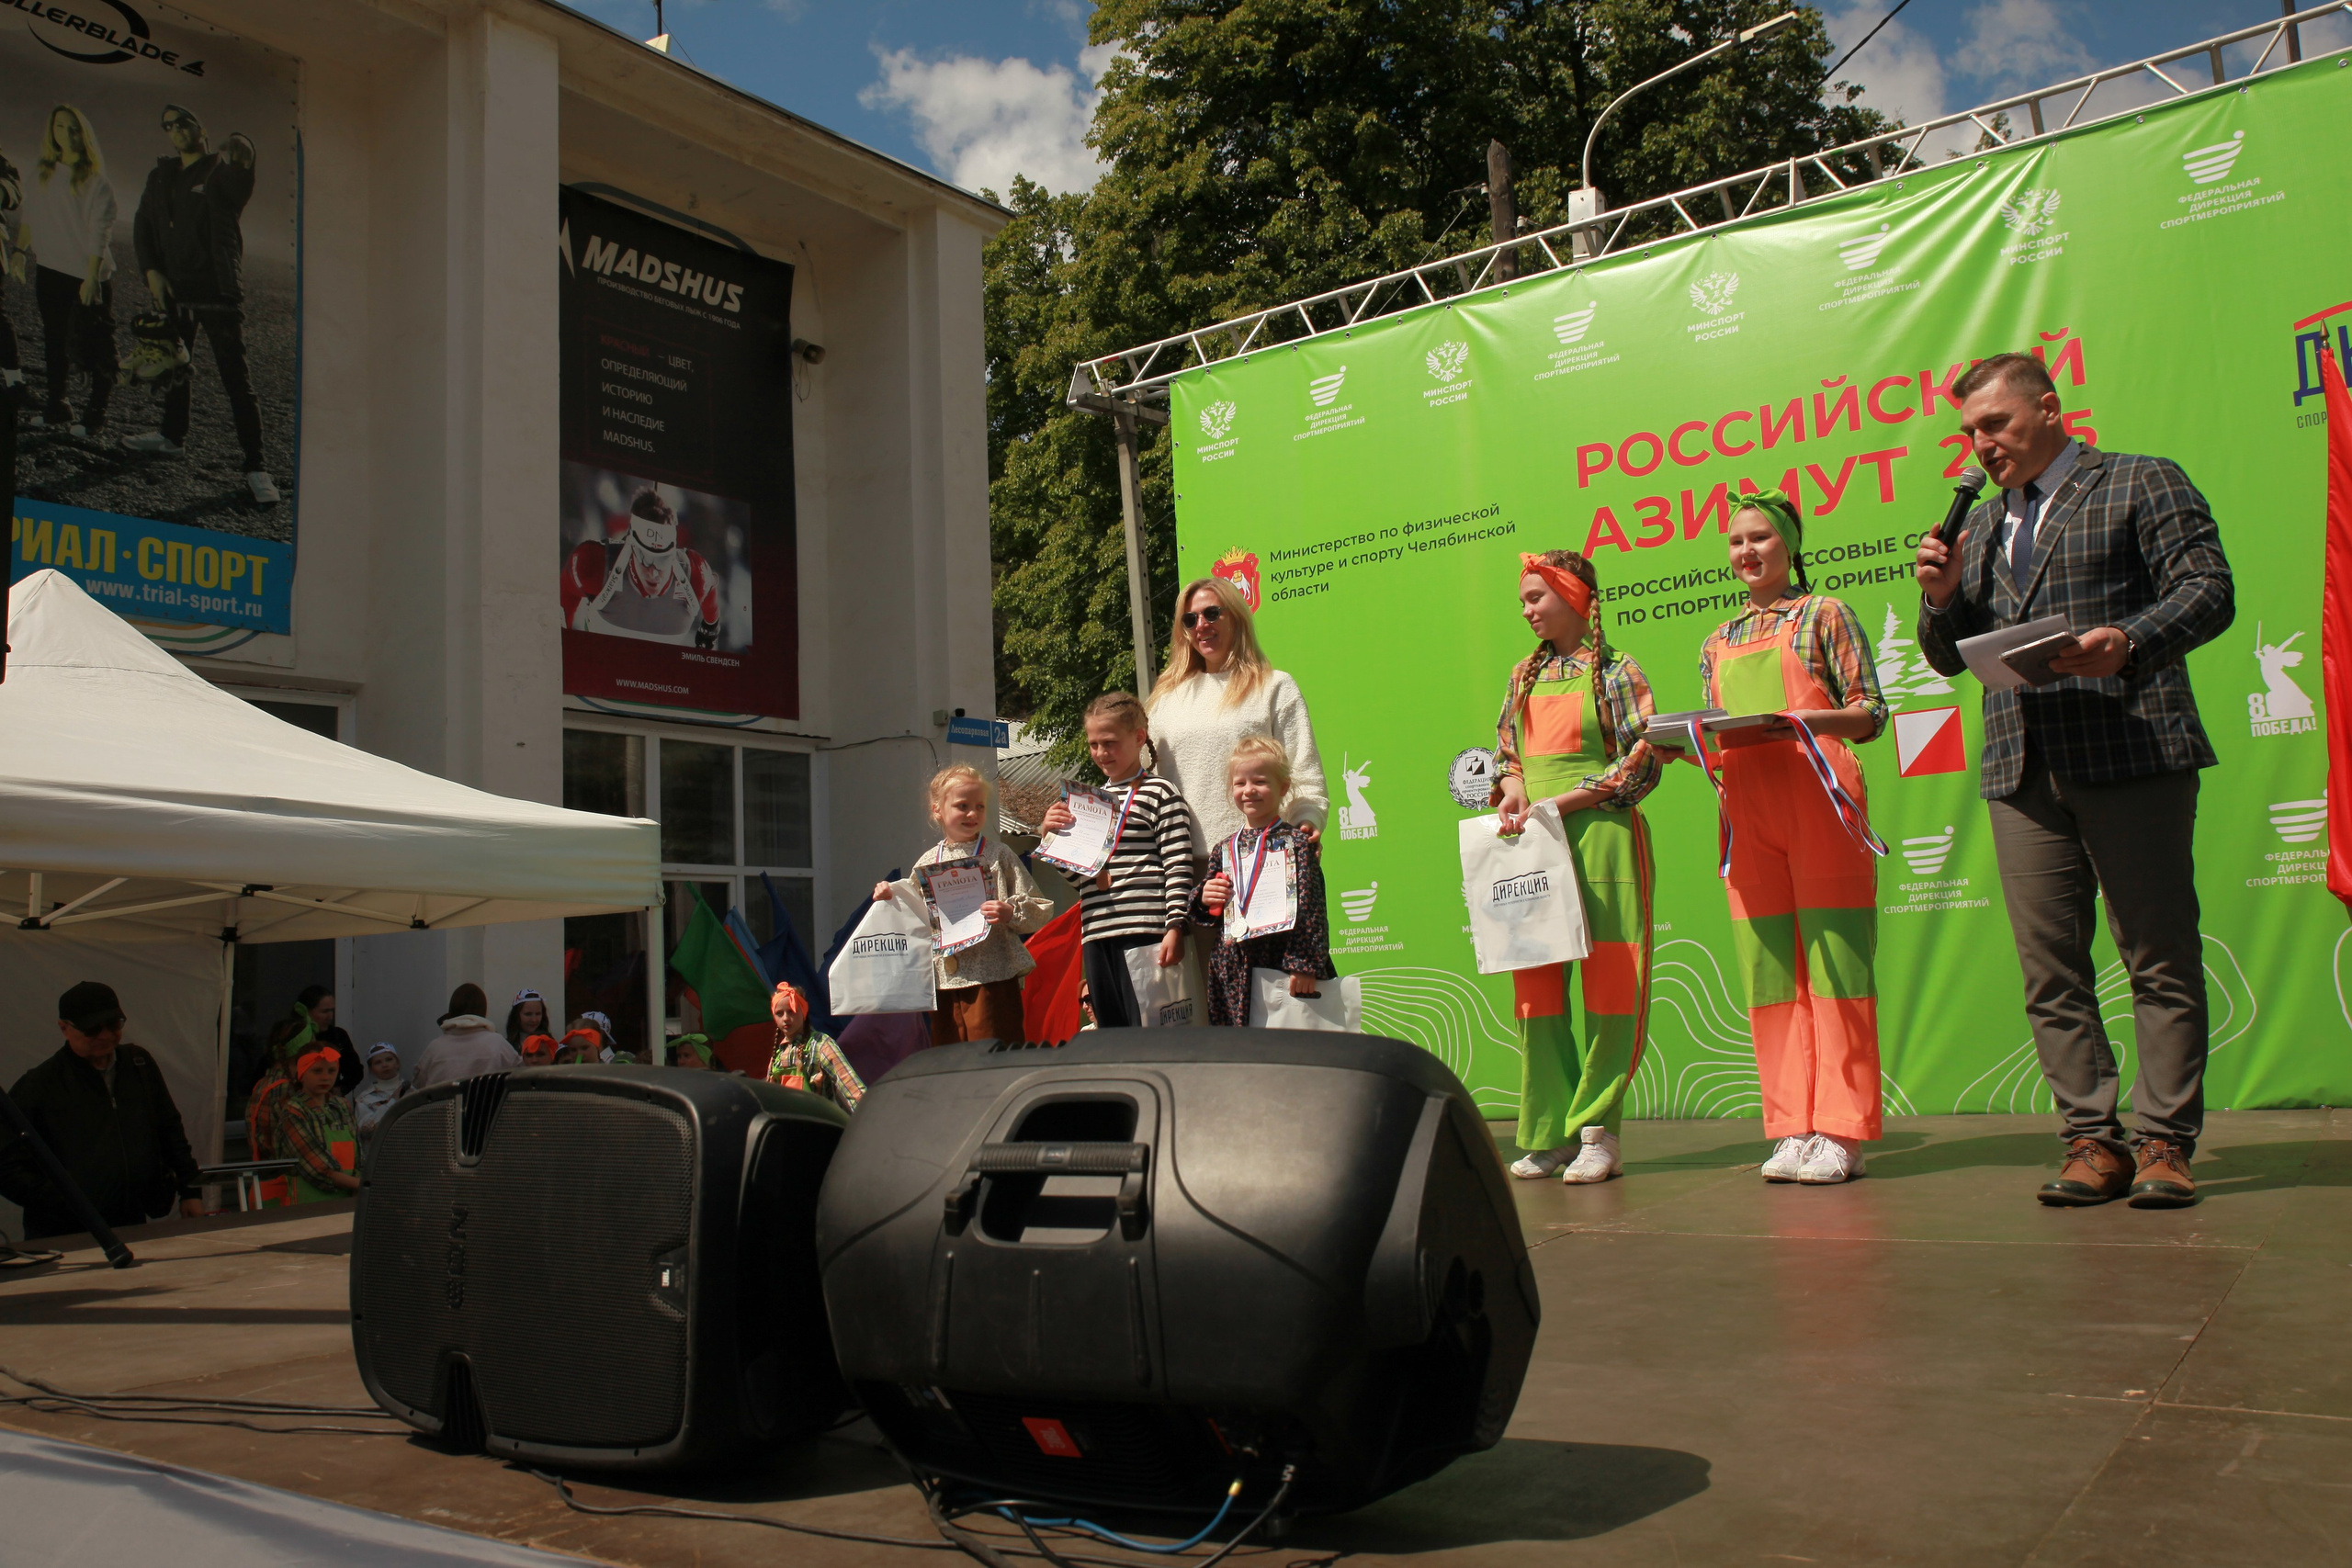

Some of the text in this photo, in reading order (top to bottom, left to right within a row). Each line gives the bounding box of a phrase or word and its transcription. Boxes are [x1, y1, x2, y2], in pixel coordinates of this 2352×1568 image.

[2177, 177, 2261, 205] ФЕДЕРАЛЬНАЯ
[2160, 190, 2286, 230] СПОРТМЕРОПРИЯТИЙ
[2188, 190, 2253, 214] ДИРЕКЦИЯ
[2000, 231, 2070, 257] МИНСПОРТ
[2009, 246, 2064, 266] РОССИИ
[582, 234, 744, 313] MADSHUS
[1833, 266, 1902, 289] ФЕДЕРАЛЬНАЯ
[1818, 279, 1921, 311] СПОРТМЕРОПРИЯТИЙ
[1841, 277, 1894, 298] ДИРЕКЦИЯ
[597, 276, 653, 301] ПРОИЗВОДСТВО
[653, 295, 685, 311] БЕГОВЫХ
[684, 305, 702, 318] ЛЫЖ
[707, 313, 723, 324] 1906
[724, 316, 741, 330] ГОДА
[1687, 311, 1746, 333] МИНСПОРТ
[1694, 324, 1739, 343] РОССИИ
[1546, 341, 1605, 360] ФЕДЕРАЛЬНАЯ
[1554, 351, 1599, 368] ДИРЕКЦИЯ
[668, 355, 695, 373] ЦВЕТ,
[1533, 353, 1621, 381] СПОРТМЕРОПРИЯТИЙ
[601, 358, 687, 392] ОПРЕДЕЛЯЮЩИЙ
[602, 382, 653, 405] ИСТОРИЮ
[1422, 379, 1474, 399] МИНСПОРТ
[1429, 392, 1468, 408] РОССИИ
[1576, 326, 2086, 489] РОССИЙСКЙ
[602, 406, 665, 432] И НАСЛЕДИЕ
[1304, 403, 1353, 423] ФЕДЕРАЛЬНАЯ
[1310, 412, 1347, 430] ДИРЕКЦИЯ
[1293, 416, 1365, 441] СПОРТМЕРОПРИЯТИЙ
[603, 430, 656, 453] MADSHUS.
[1196, 437, 1239, 456] МИНСПОРТ
[1938, 409, 2098, 479] 25
[1202, 449, 1235, 463] РОССИИ
[1269, 502, 1500, 563] Министерство по физической
[1271, 521, 1516, 584] культуре и спорту Челябинской
[1597, 566, 1738, 604] СЕРОССИЙСК
[1802, 536, 1897, 567] ССОВЫЕ
[85, 578, 263, 618] www.trial-sport.ru
[1271, 580, 1329, 603] области
[1617, 608, 1646, 626] ПО
[681, 651, 741, 668] ЭМИЛЬ СВЕНДСЕН
[616, 678, 689, 694] WWW.MADSHUS.COM
[2250, 716, 2317, 738] ПОБЕДА!
[1073, 802, 1107, 816] ГРАМОТА
[1340, 826, 1378, 840] ПОБЕДА!
[2264, 849, 2330, 863] ФЕДЕРАЛЬ
[2277, 861, 2327, 874] ДИРЕКЦ
[937, 875, 978, 888] ГРАМОТА
[1492, 876, 1549, 902] ДИРЕКЦИЯ
[1898, 878, 1969, 892] ФЕДЕРАЛЬНАЯ
[2245, 874, 2327, 887] СПОРТМЕРОП
[1883, 897, 1989, 914] СПОРТМЕРОПРИЯТИЙ
[1908, 889, 1962, 903] ДИРЕКЦИЯ
[1339, 925, 1388, 936] ФЕДЕРАЛЬНАЯ
[1345, 935, 1384, 946] ДИРЕКЦИЯ
[853, 938, 908, 954] ДИРЕКЦИЯ
[1329, 942, 1404, 954] СПОРТМЕРОПРИЯТИЙ
[1159, 1003, 1193, 1026] ДИРЕКЦИЯ
